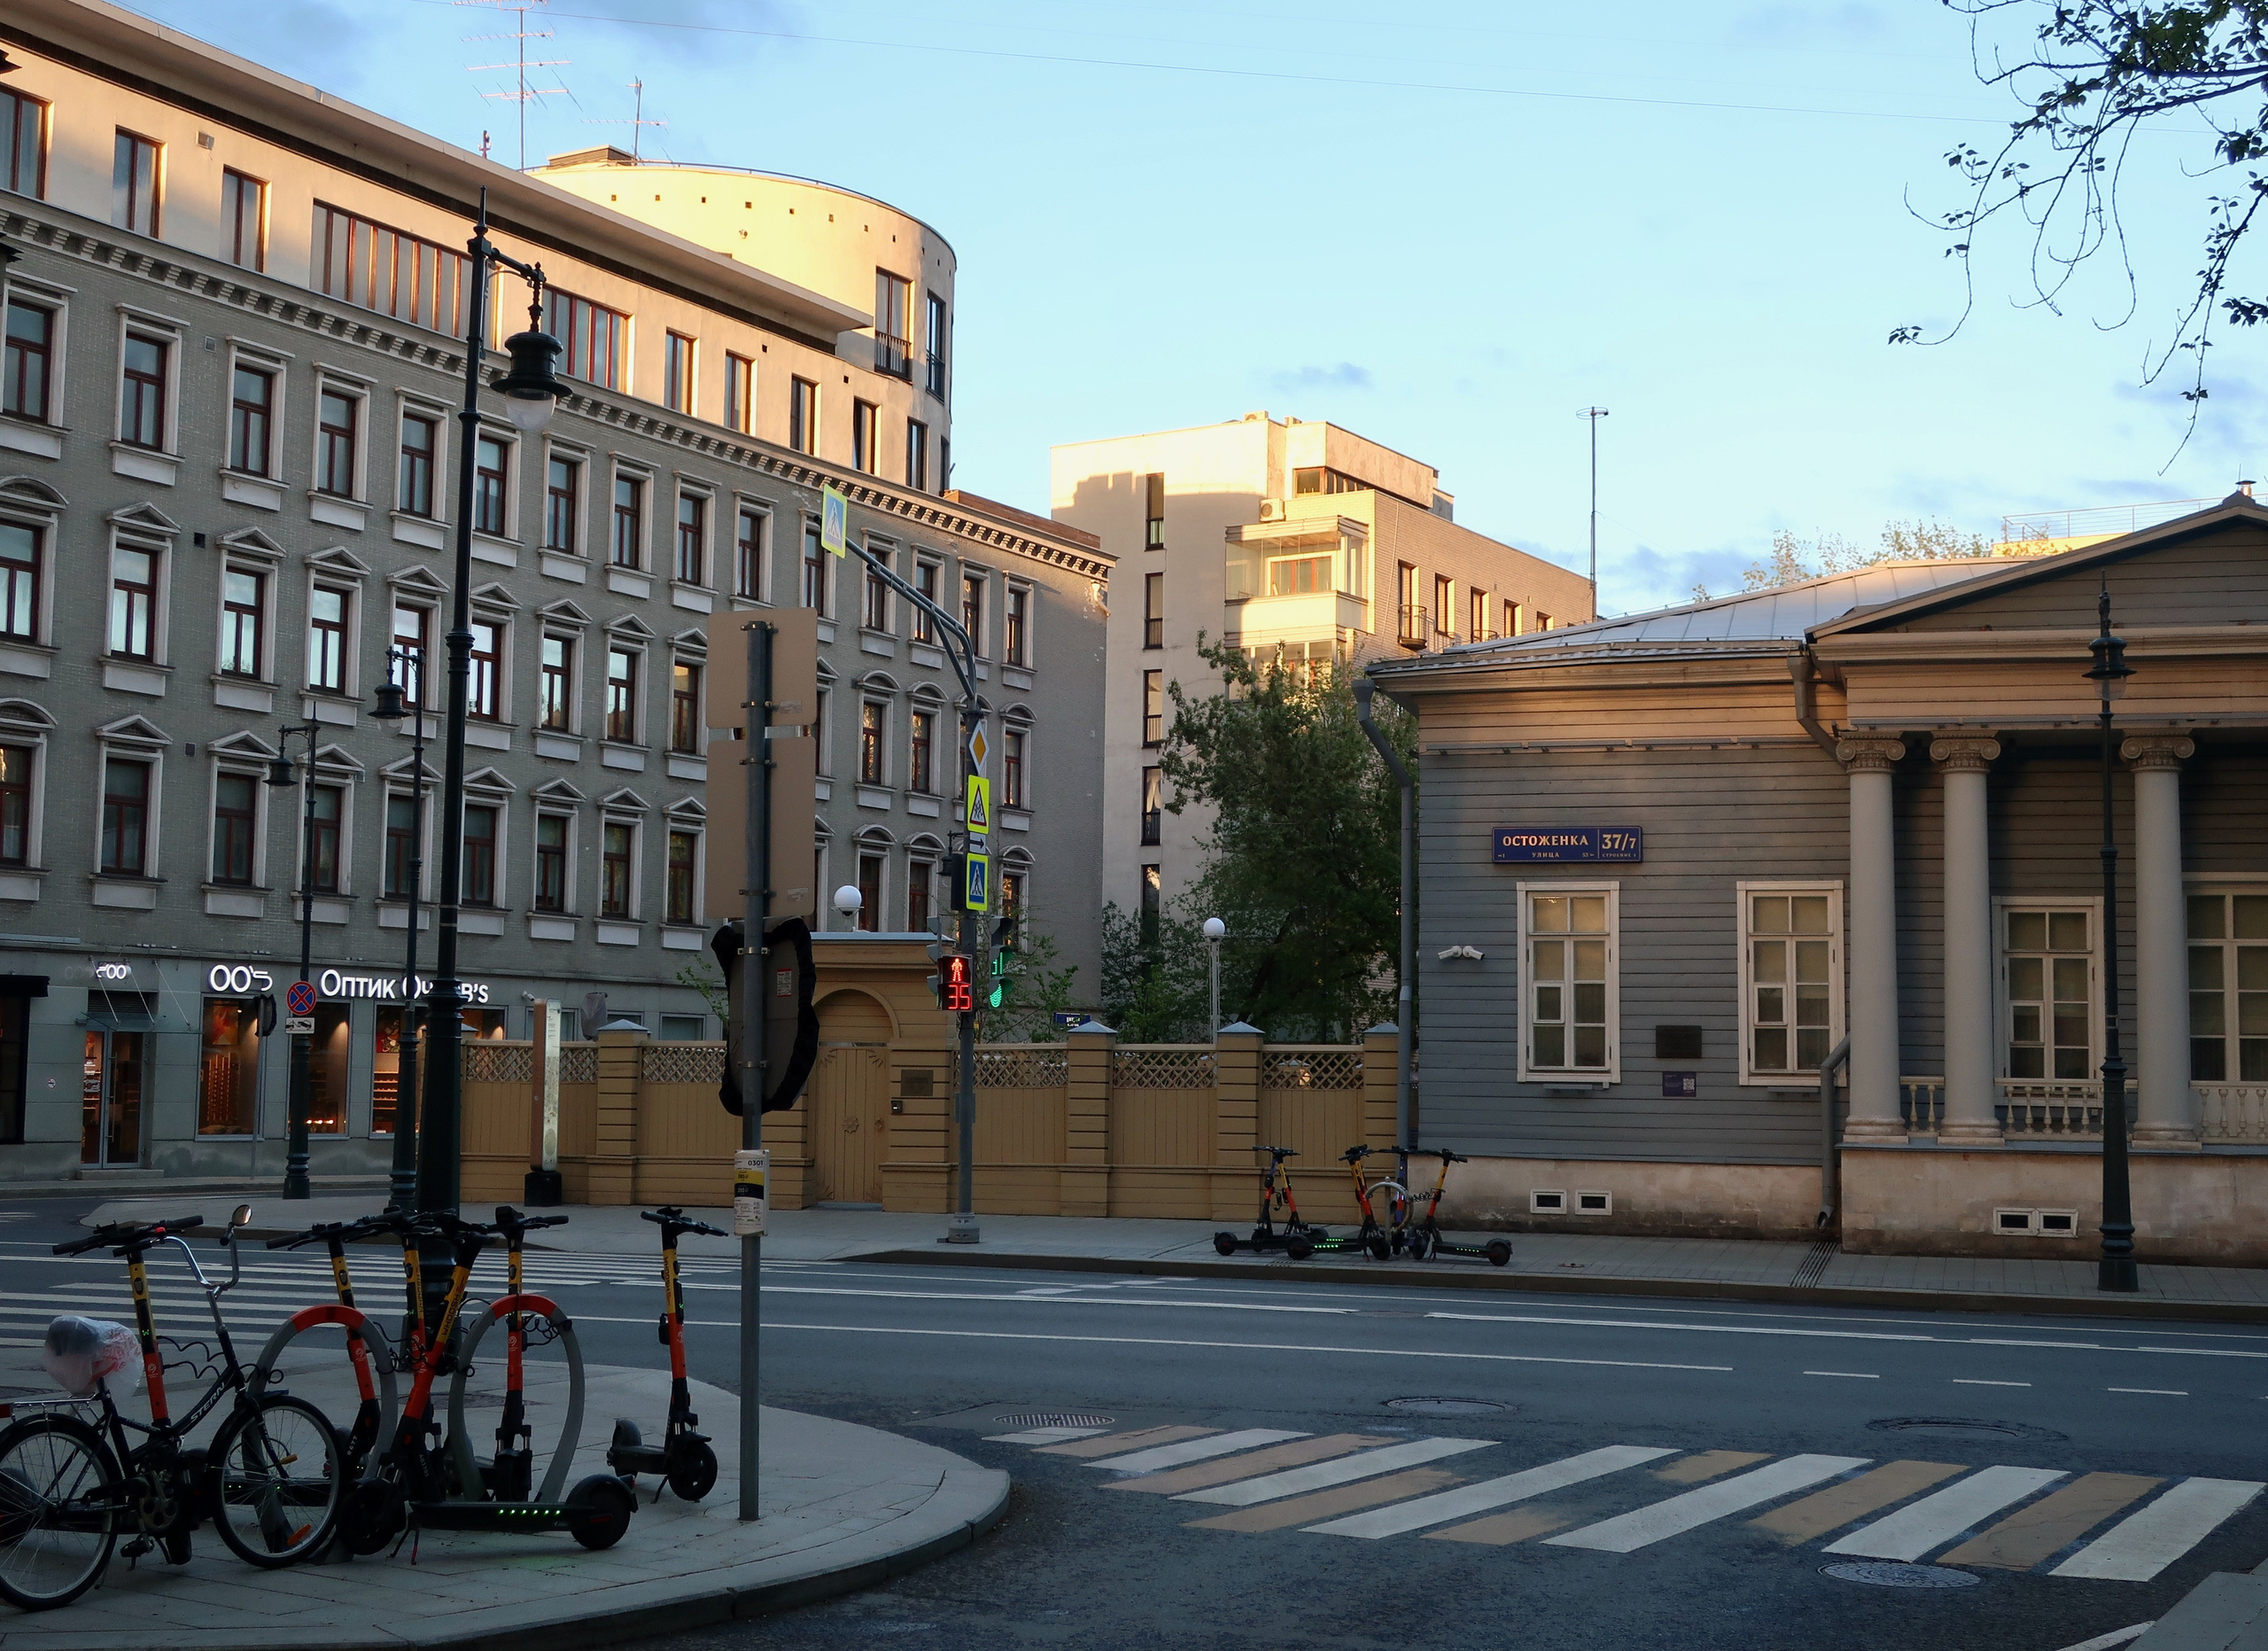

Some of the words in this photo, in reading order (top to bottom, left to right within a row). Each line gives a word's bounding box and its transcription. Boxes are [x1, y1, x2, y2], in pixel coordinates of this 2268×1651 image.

[1502, 835, 1589, 846] ОСТОЖЕНКА
[1602, 833, 1636, 852] 37/7
[948, 985, 971, 1009] 35
[441, 1293, 461, 1336] WHOOSH
[190, 1381, 225, 1423] STERN
